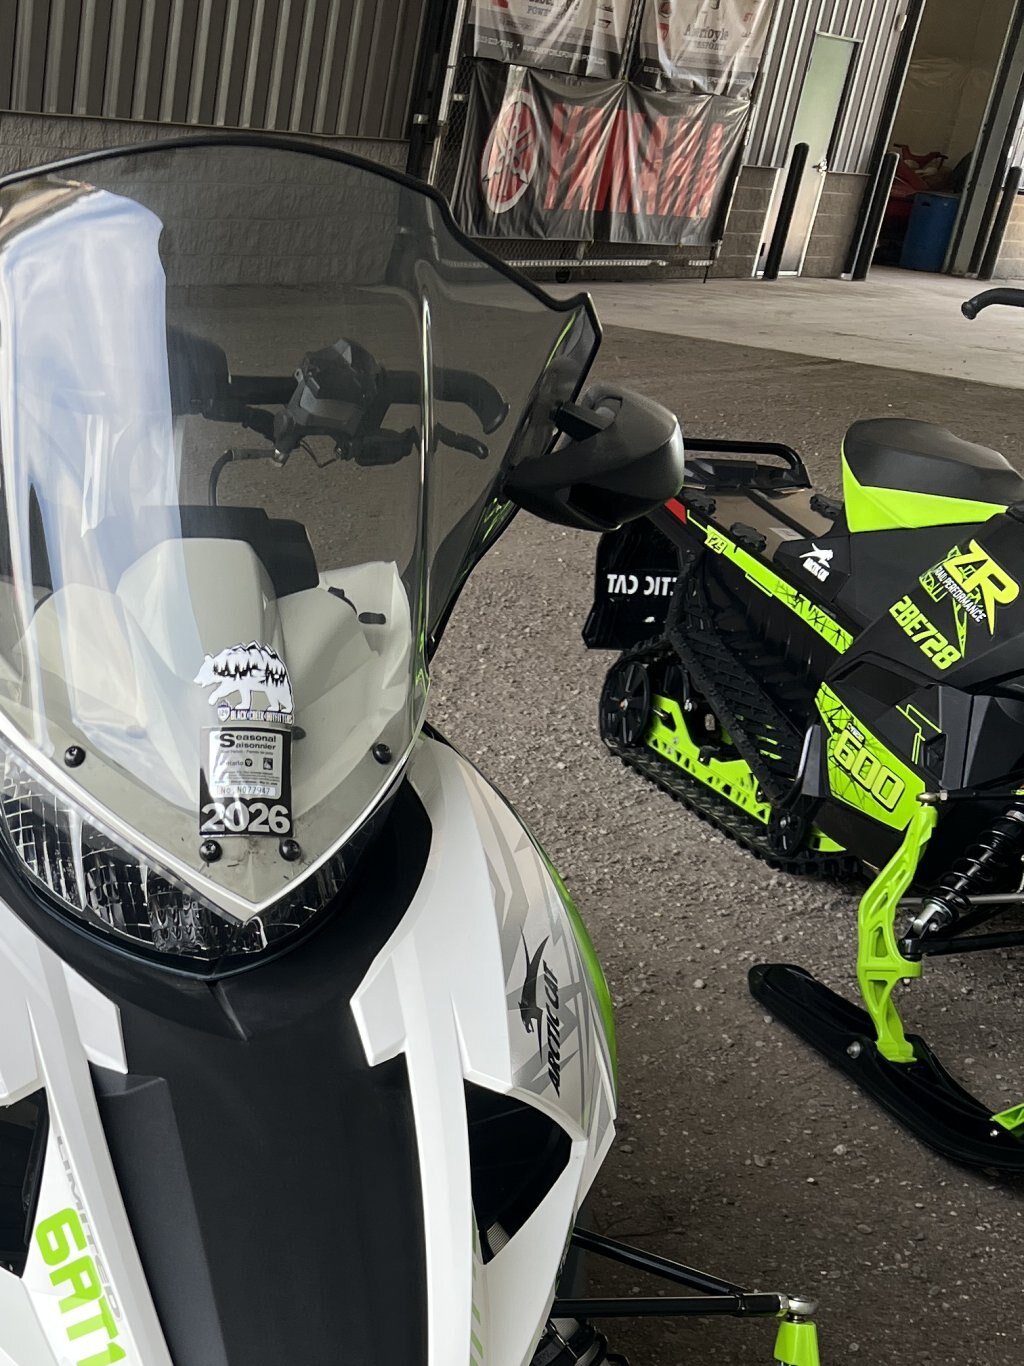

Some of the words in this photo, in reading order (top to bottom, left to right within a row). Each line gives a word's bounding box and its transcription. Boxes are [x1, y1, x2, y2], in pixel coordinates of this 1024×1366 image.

[544, 103, 724, 218] YAMAHA
[943, 539, 1020, 636] ZR
[944, 577, 987, 622] PERFORMANCE
[889, 595, 962, 670] 2BE728
[219, 733, 277, 745] Seasonal
[834, 730, 905, 810] 600
[201, 803, 291, 835] 2026
[543, 959, 559, 1010] CAT
[546, 1002, 560, 1098] ARCTIC
[57, 1136, 122, 1320] LIMITED
